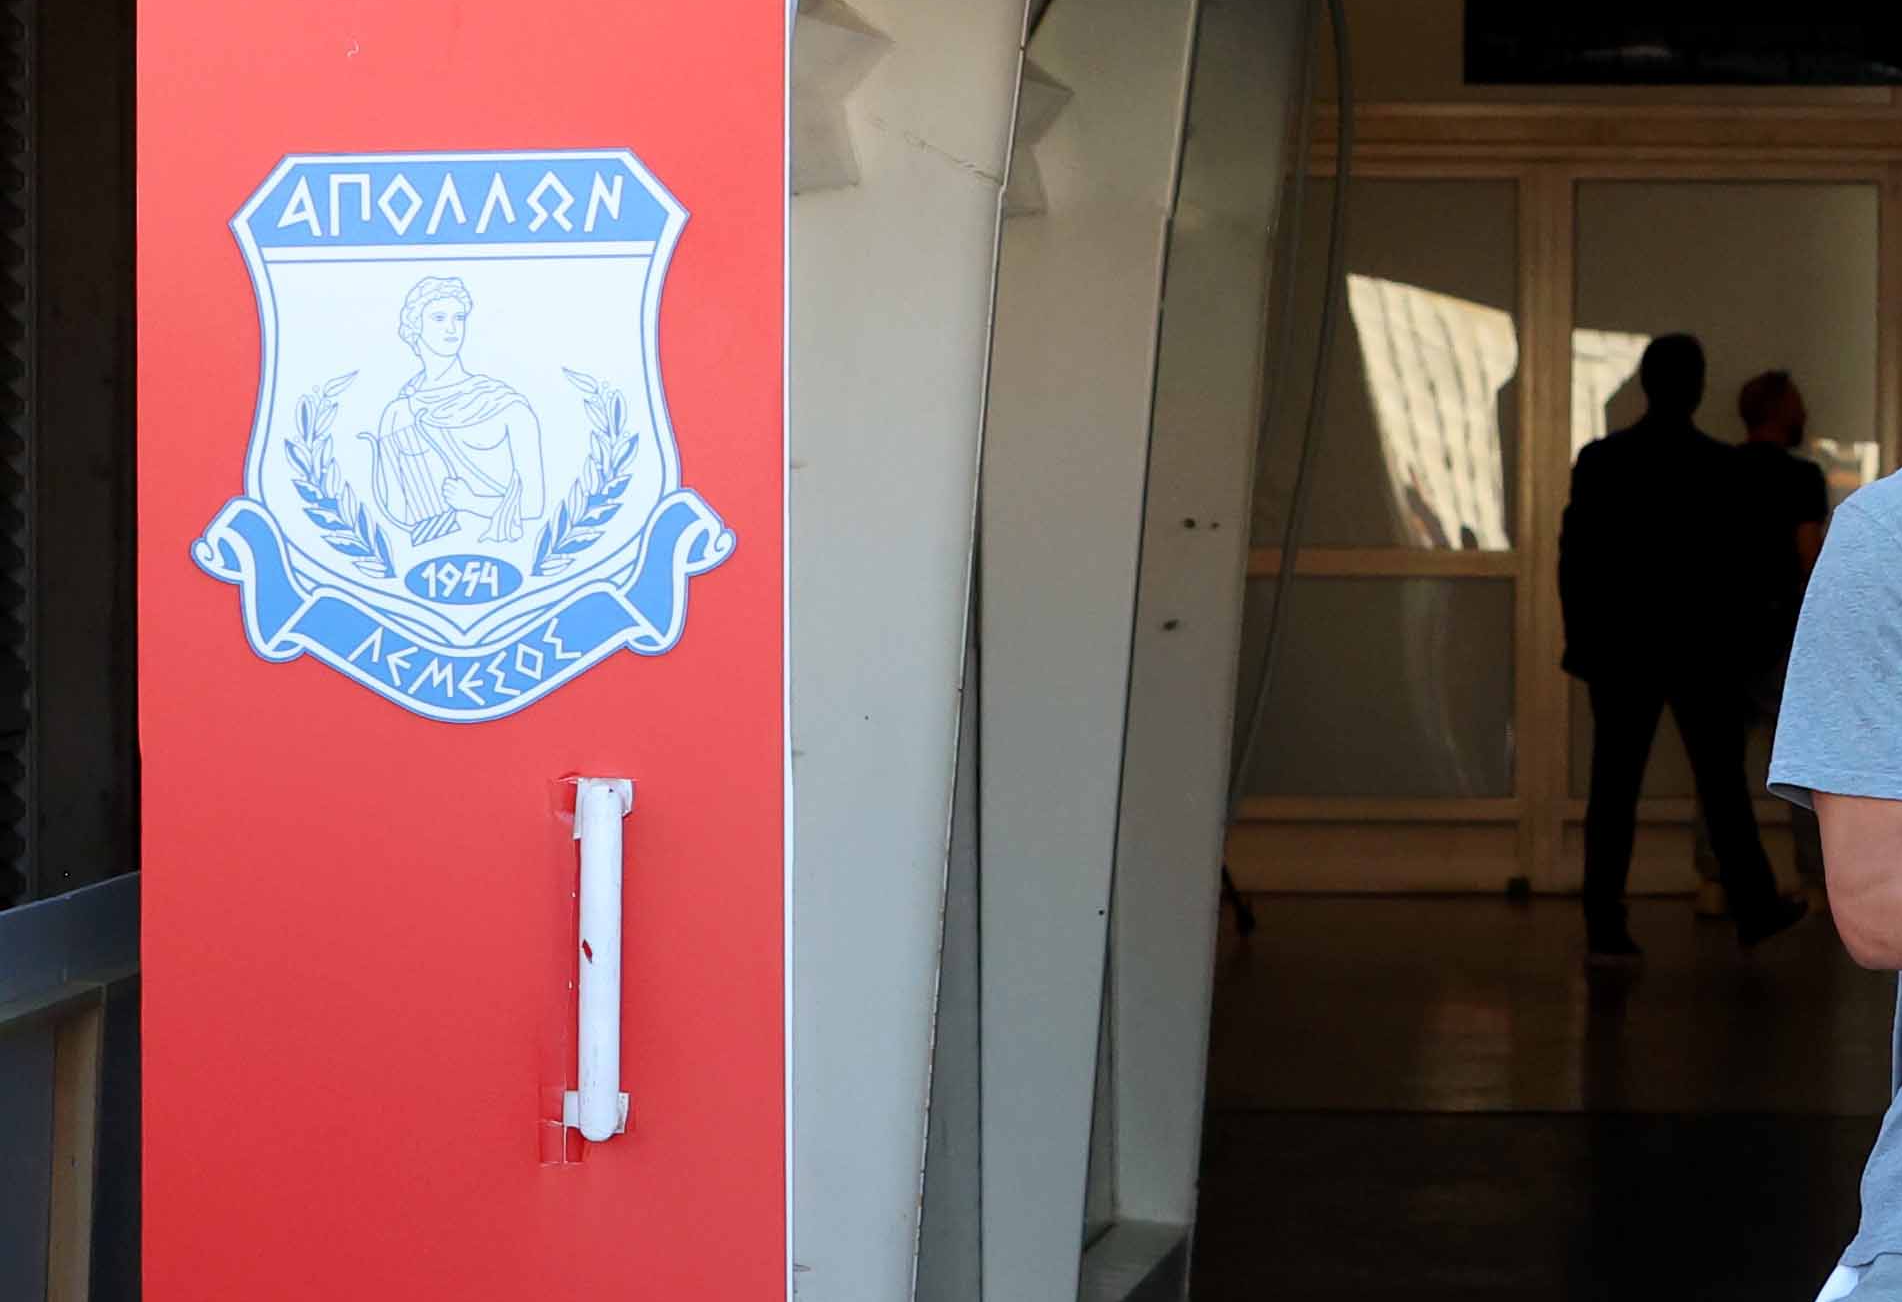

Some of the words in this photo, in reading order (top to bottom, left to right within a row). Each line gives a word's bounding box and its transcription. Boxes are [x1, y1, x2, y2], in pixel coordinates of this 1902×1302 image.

[276, 169, 624, 238] ΑΠΟΛΛΩΝ
[420, 560, 500, 599] 1954
[346, 617, 584, 706] ΛΕΜΕΣΟΣ
